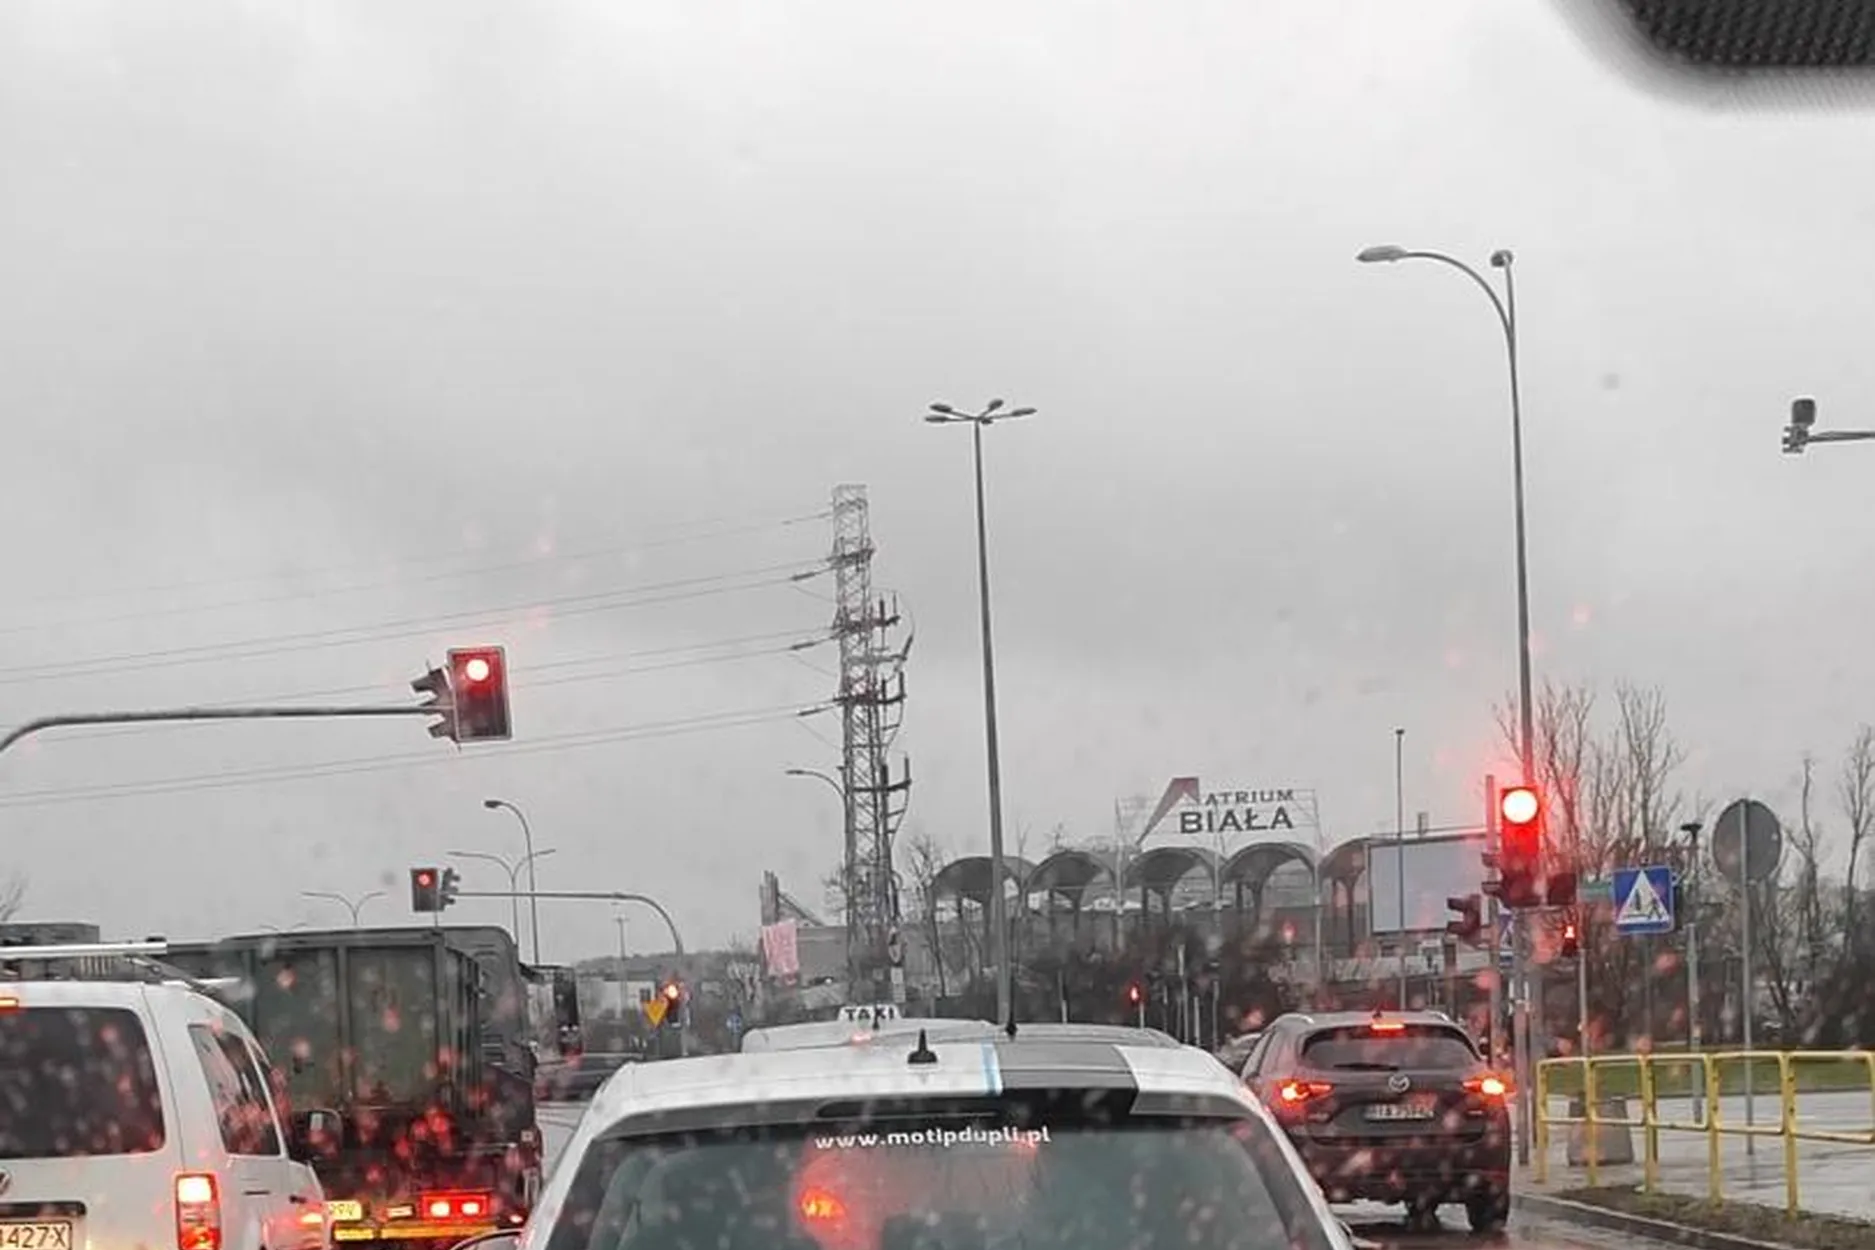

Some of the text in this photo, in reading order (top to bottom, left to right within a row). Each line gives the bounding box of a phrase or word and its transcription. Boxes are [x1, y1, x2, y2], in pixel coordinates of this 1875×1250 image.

[1205, 789, 1294, 806] ATRIUM
[1180, 806, 1294, 834] BIAŁA
[815, 1126, 1051, 1149] www.motipdupli.pl
